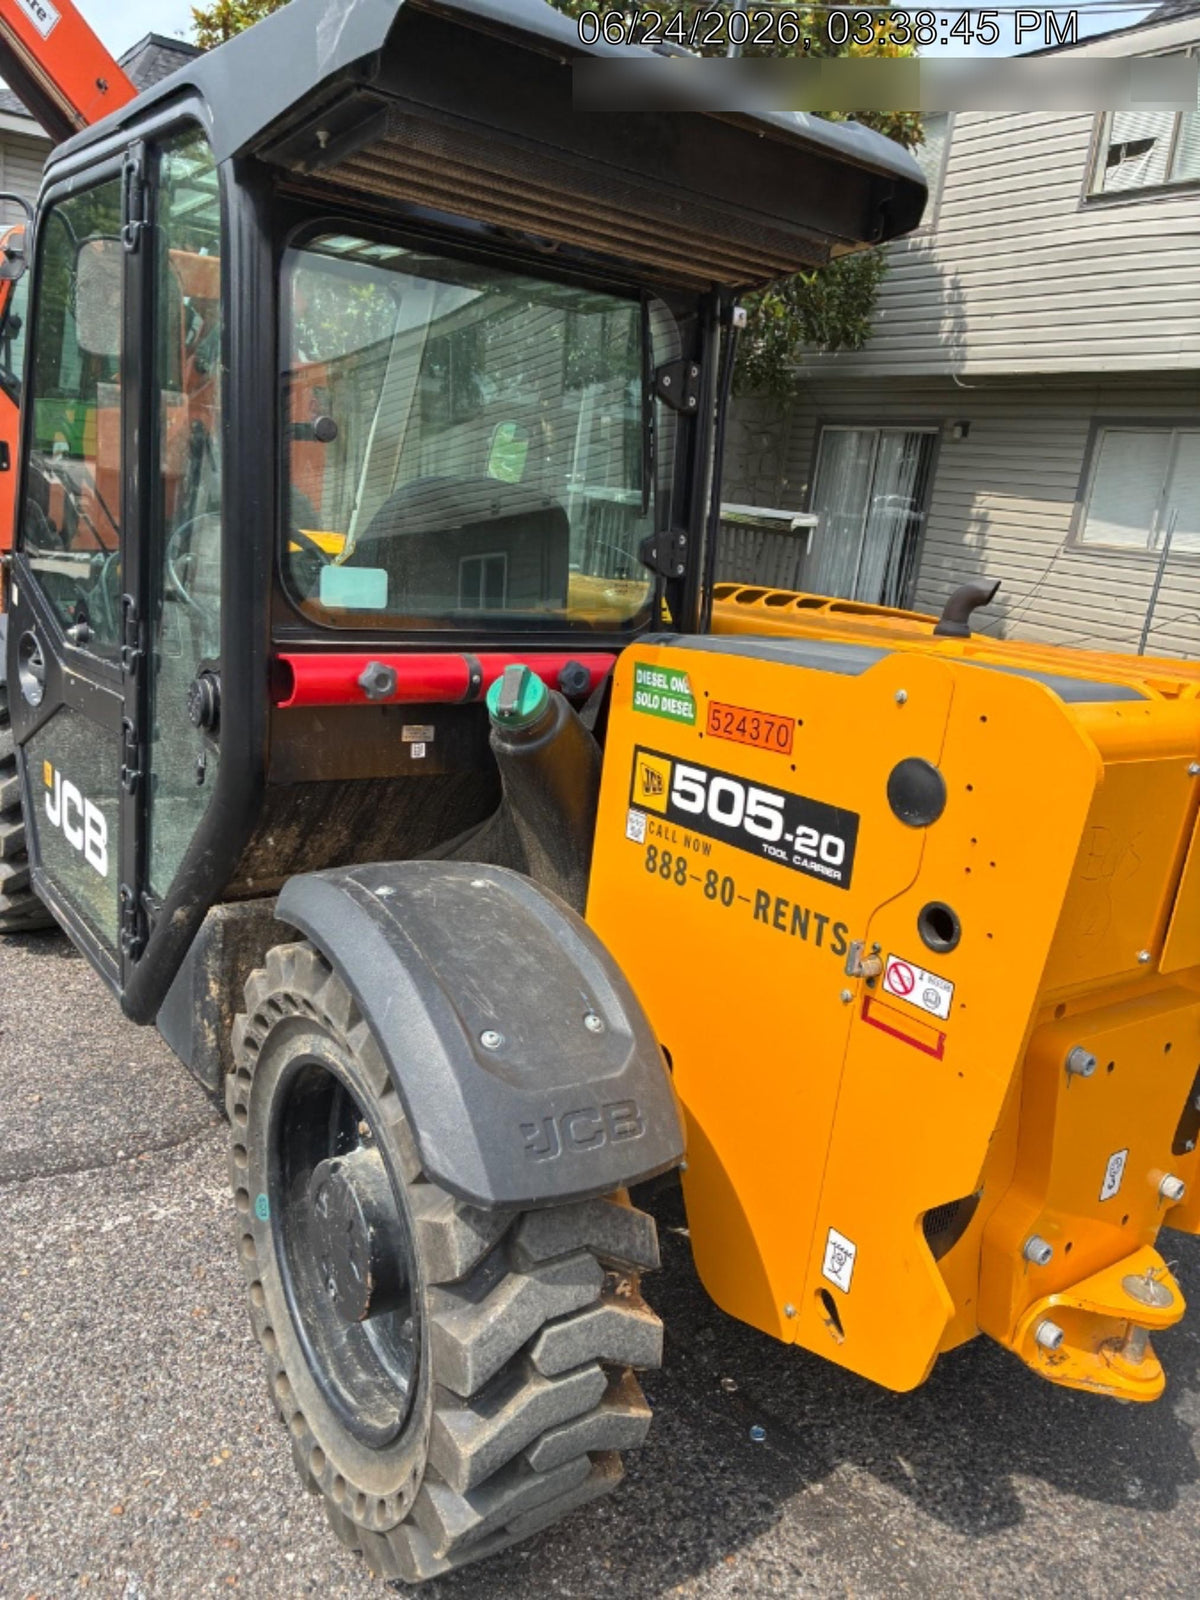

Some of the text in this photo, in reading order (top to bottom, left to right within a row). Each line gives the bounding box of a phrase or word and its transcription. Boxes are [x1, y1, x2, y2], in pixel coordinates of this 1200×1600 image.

[26, 0, 47, 21] re
[636, 669, 692, 694] DIESEL ONL
[634, 690, 695, 719] SOLO DIESEL
[711, 708, 790, 748] 524370
[641, 764, 664, 796] JCB
[44, 766, 109, 878] JCB
[648, 820, 713, 857] CALL NOW
[762, 843, 842, 881] TOOL CARRIER
[645, 844, 849, 957] 888-80-RENTS
[523, 1098, 647, 1163] JCB
